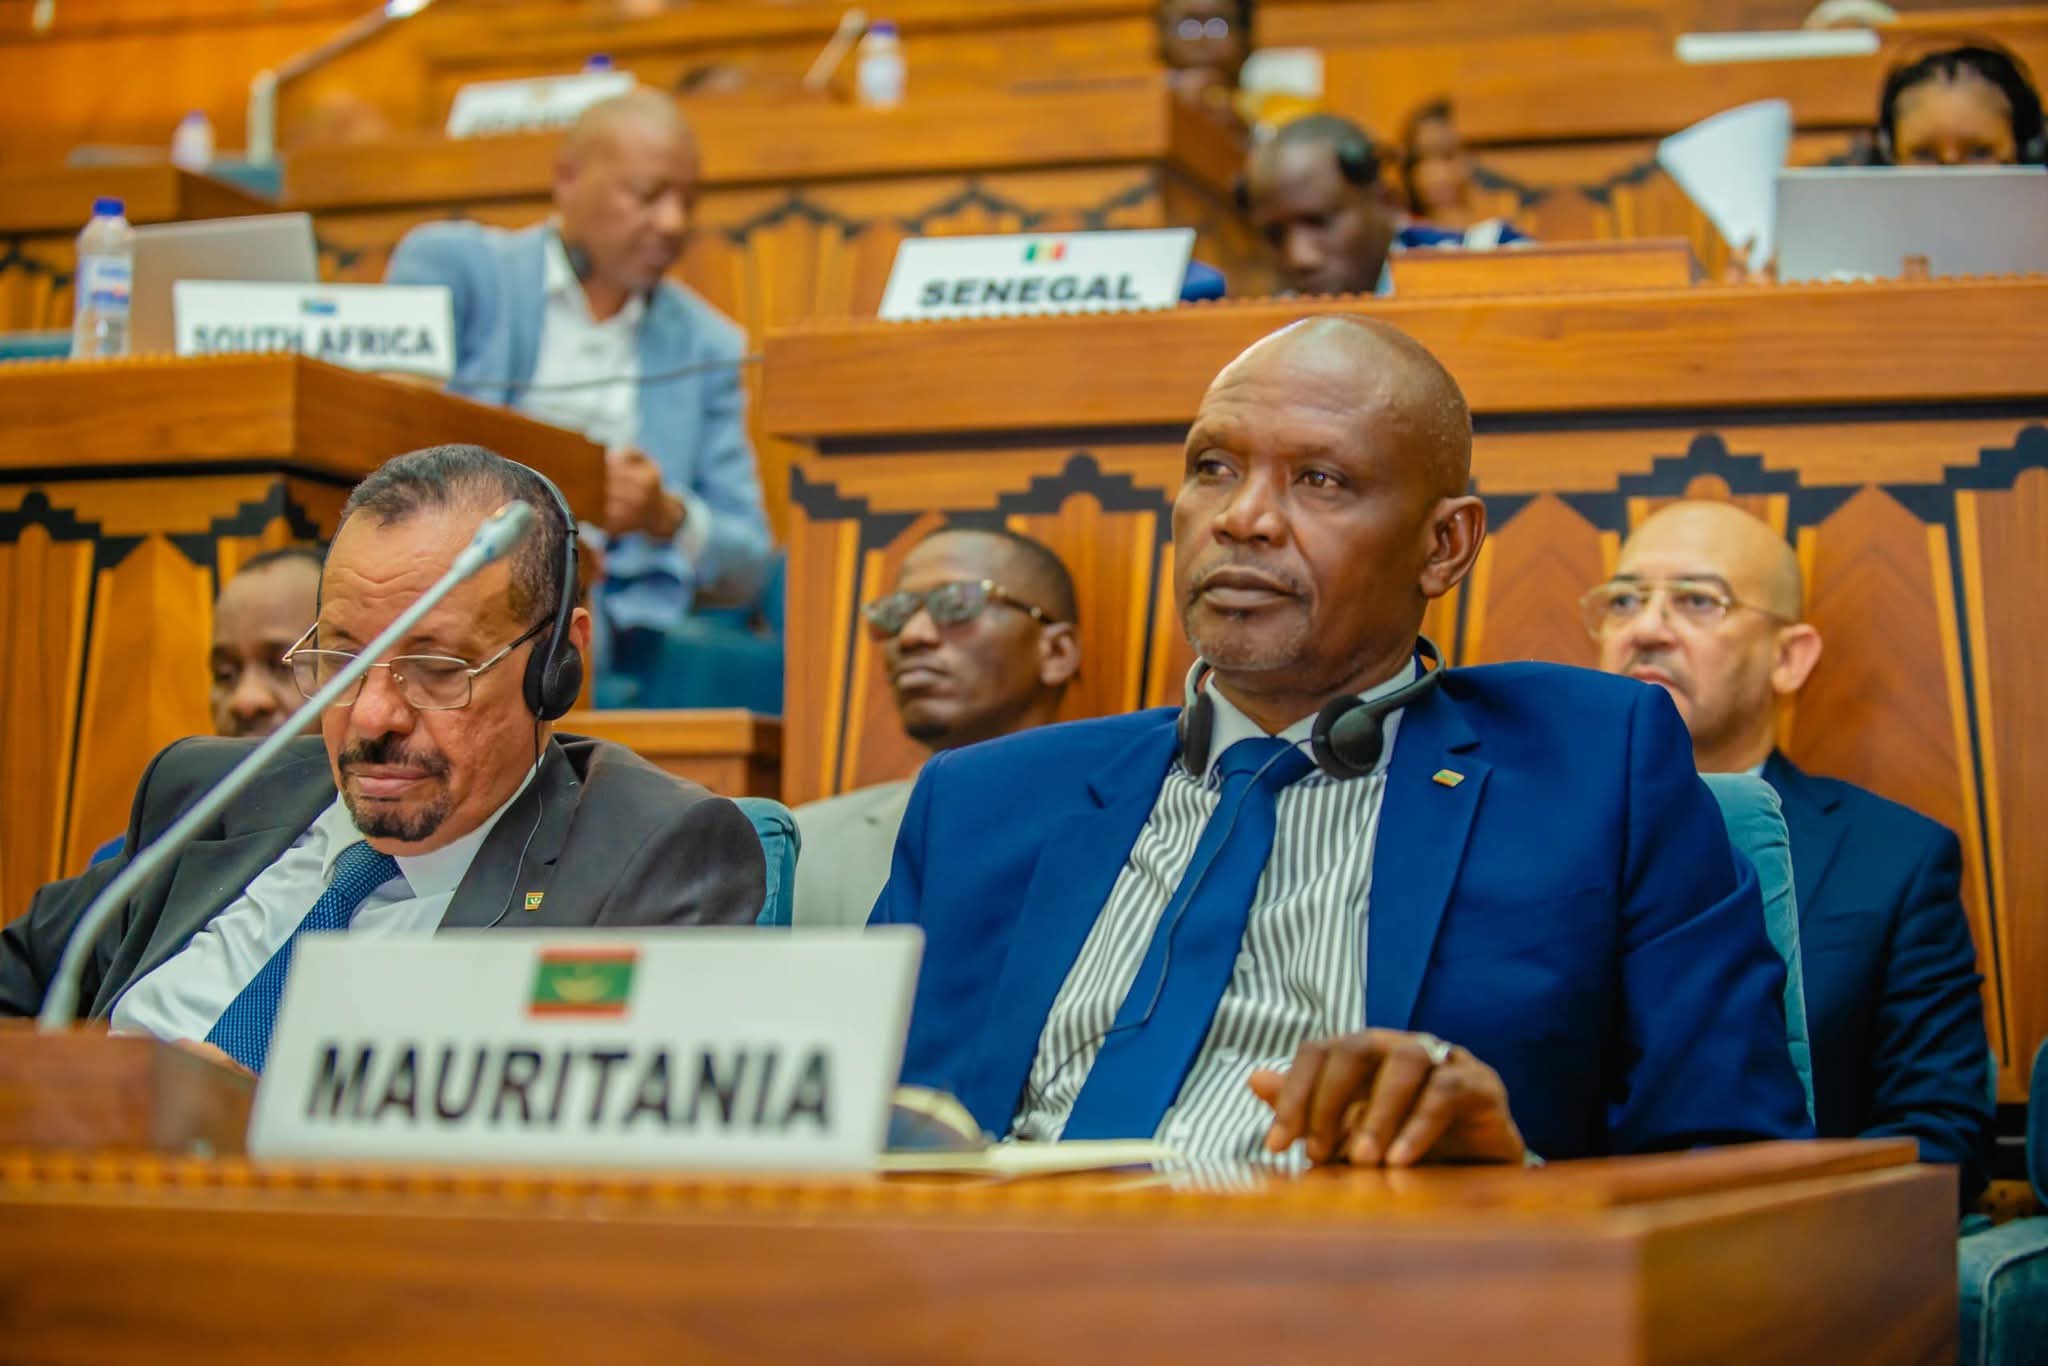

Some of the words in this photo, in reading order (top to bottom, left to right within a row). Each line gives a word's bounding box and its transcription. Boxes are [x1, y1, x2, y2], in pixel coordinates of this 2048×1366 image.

[920, 273, 1140, 307] SENEGAL
[192, 322, 304, 354] SOUTH
[317, 325, 436, 357] AFRICA
[304, 1041, 836, 1132] MAURITANIA
